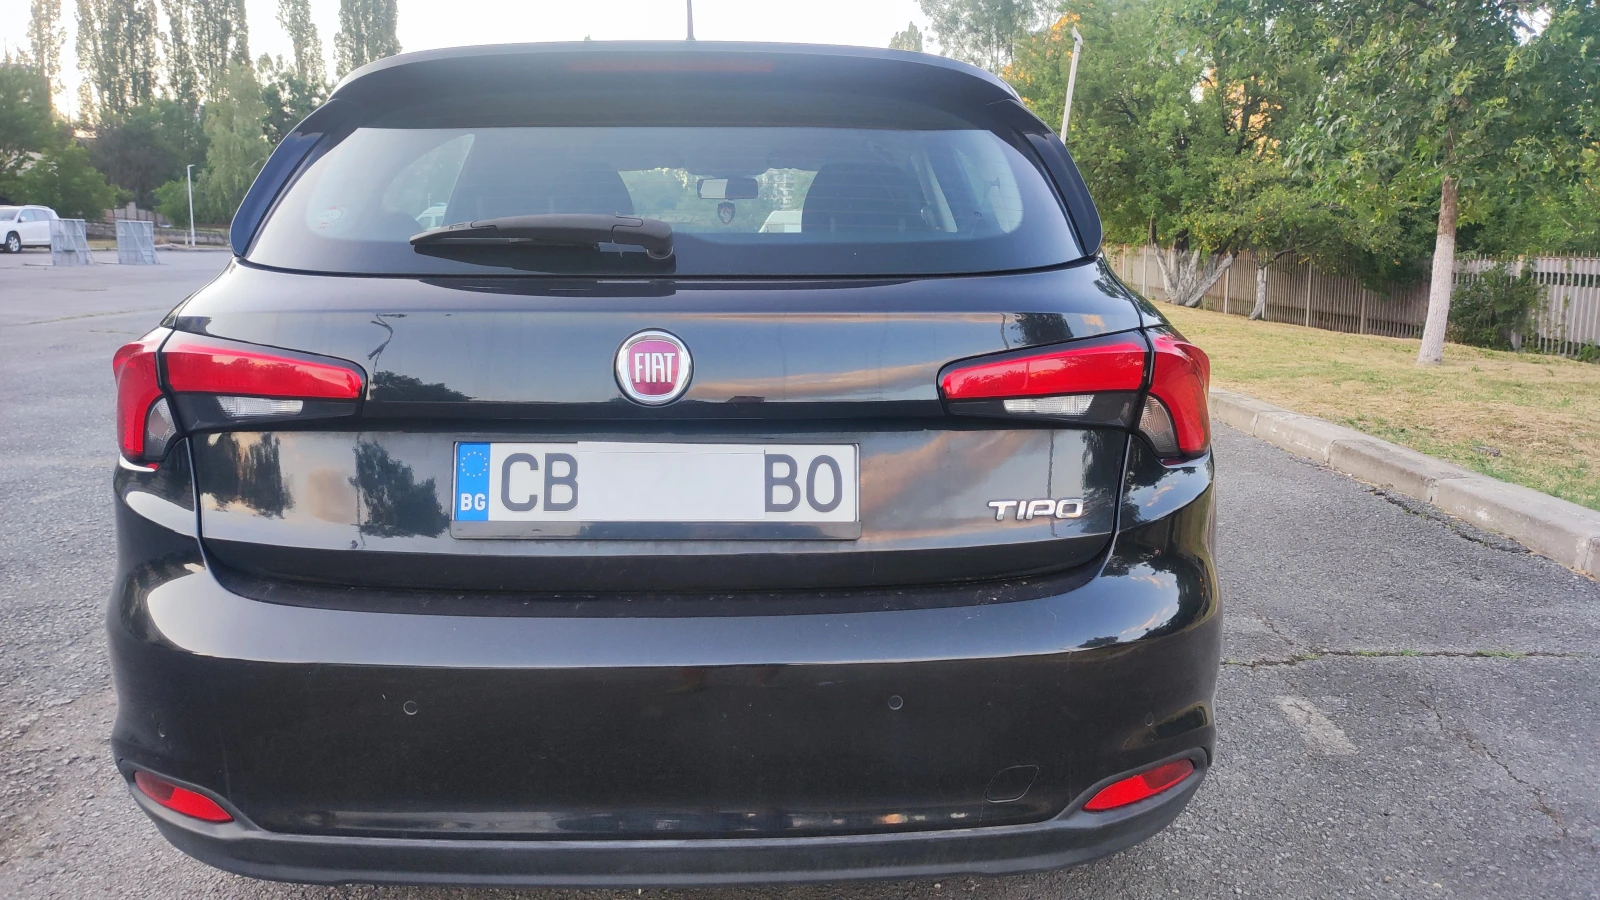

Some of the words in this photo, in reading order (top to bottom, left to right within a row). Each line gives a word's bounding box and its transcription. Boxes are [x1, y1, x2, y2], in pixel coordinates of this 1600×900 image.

[634, 352, 676, 383] FIAT
[500, 452, 579, 512] CB
[460, 493, 486, 511] BG
[988, 498, 1084, 520] TIPO
